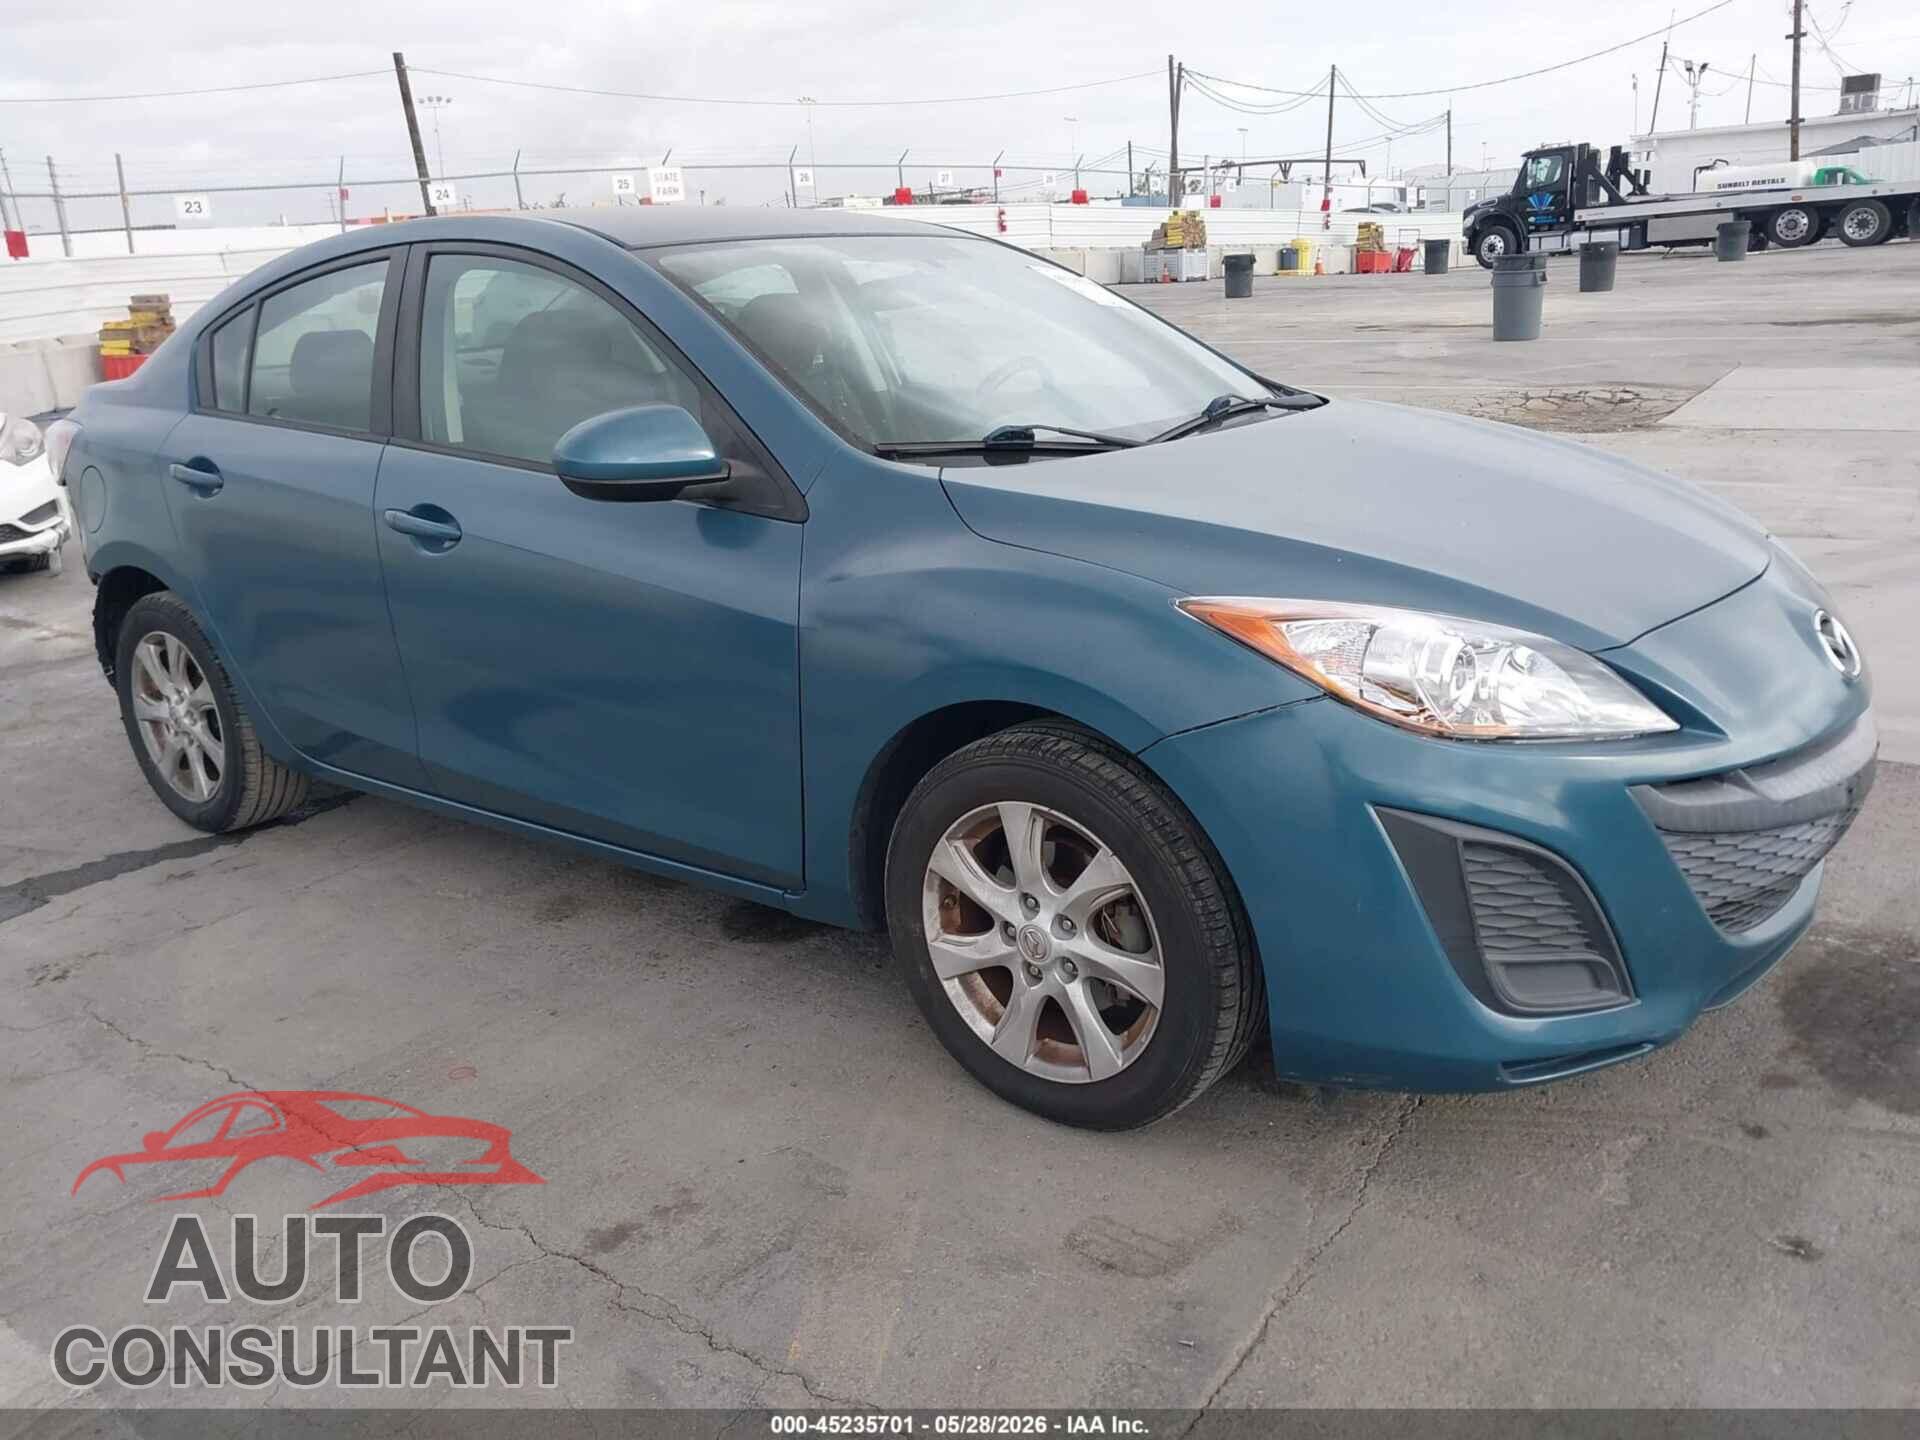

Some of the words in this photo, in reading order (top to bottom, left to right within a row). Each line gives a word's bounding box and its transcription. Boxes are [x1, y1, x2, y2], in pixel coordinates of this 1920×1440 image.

[617, 179, 630, 190] 25
[435, 189, 449, 201] 24
[184, 201, 202, 214] 23
